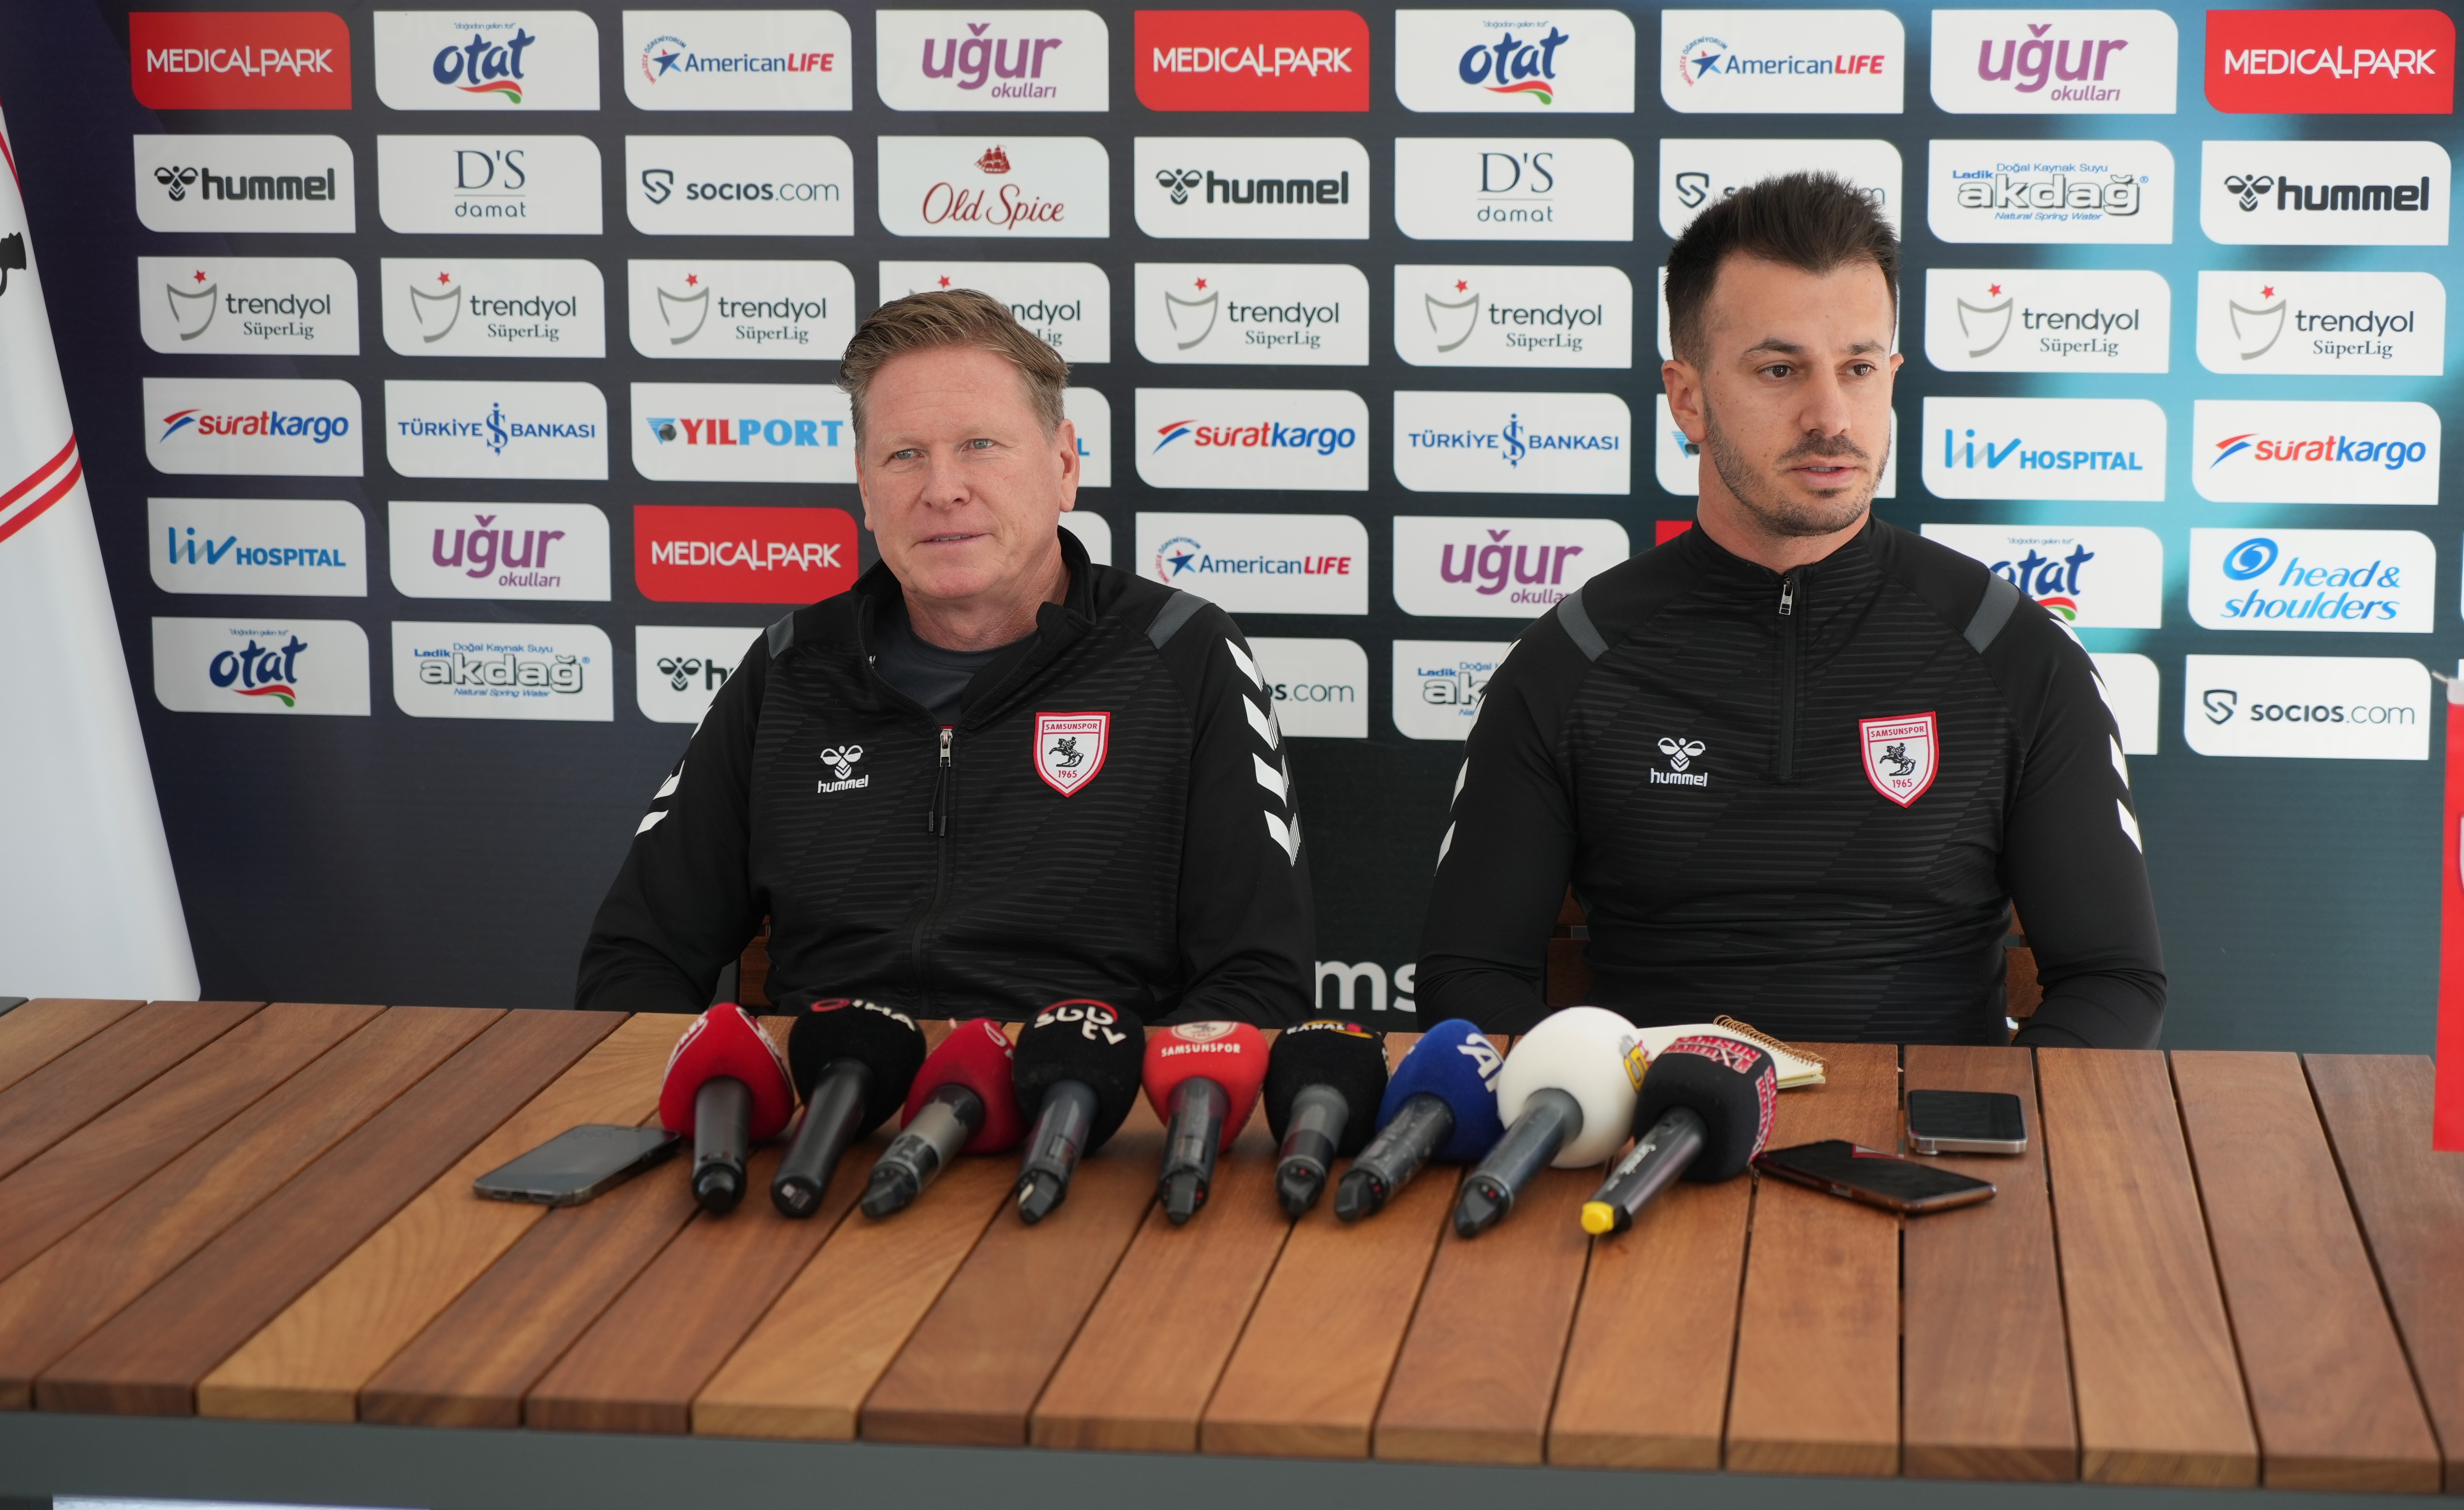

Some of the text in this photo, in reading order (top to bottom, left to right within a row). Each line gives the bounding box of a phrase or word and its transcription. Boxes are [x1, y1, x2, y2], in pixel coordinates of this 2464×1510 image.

[147, 45, 333, 77] MEDICALPARK
[433, 28, 536, 85] otat
[685, 53, 834, 72] AmericanLIFE
[922, 23, 1062, 90] uğur
[1153, 44, 1352, 77] MEDICALPARK
[1459, 27, 1569, 85] otat
[1725, 55, 1884, 74] AmericanLIFE
[1978, 24, 2128, 93] uğur
[2225, 45, 2437, 79] MEDICALPARK
[991, 83, 1056, 98] okulları
[2051, 85, 2121, 101] okulları
[453, 150, 525, 189] D'S
[1479, 153, 1553, 193] D'S
[1952, 170, 1993, 179] Ladik
[1996, 163, 2108, 174] Doğal Kaynak Suyu
[201, 167, 335, 201] hummel
[687, 183, 839, 201] socios.com
[1207, 170, 1349, 204] hummel
[2277, 176, 2429, 211] hummel
[1957, 174, 2140, 216] akdağ
[455, 201, 526, 217] damat
[923, 182, 1064, 230] Old Spice
[1477, 206, 1553, 222] damat
[2035, 213, 2068, 222] Spring
[225, 293, 330, 319] trendyol
[470, 295, 576, 321] trendyol
[718, 297, 826, 323] trendyol
[1012, 300, 1080, 325] ndyol
[1227, 301, 1338, 328] trendyol
[1488, 303, 1601, 330] trendyol
[2022, 308, 2139, 335] trendyol
[2295, 310, 2414, 337] trendyol
[244, 322, 314, 340] SüperLig
[488, 324, 559, 342] SüperLig
[736, 326, 808, 344] SüperLig
[1246, 331, 1320, 349] SüperLig
[1506, 333, 1582, 352] SüperLig
[2040, 338, 2119, 357] SüperLig
[2313, 340, 2393, 359] SüperLig
[398, 418, 483, 436] TÜRKİYE
[511, 423, 595, 438] BANKASI
[680, 418, 843, 447] YILPORT
[1408, 430, 1499, 448] TÜRKİYE
[1529, 435, 1618, 450] BANKASI
[1945, 429, 2143, 470] liv HOSPITAL
[168, 527, 346, 567] liv HOSPITAL
[432, 515, 565, 578] uğur
[651, 539, 841, 572] MEDICALPARK
[1199, 555, 1351, 575] AmericanLIFE
[1440, 529, 1584, 595] uğur
[2279, 557, 2381, 587] head
[498, 572, 560, 587] okulları
[1511, 589, 1572, 603] okulla
[2220, 589, 2401, 620] shoulders
[414, 649, 451, 658] Ladik
[453, 643, 553, 654] Doğal Kaynak Suyu
[210, 635, 308, 688] otat
[1460, 662, 1492, 671] Doğal
[420, 652, 583, 693] akdağ
[1419, 668, 1457, 676] Ladik
[489, 689, 519, 698] Spring
[2250, 704, 2414, 724] socios.com
[1045, 722, 1098, 731] SAMSUNSPOR
[1870, 726, 1924, 738] SAMSUNSPOR
[817, 775, 869, 793] hummel
[1058, 770, 1078, 778] 1965
[1650, 768, 1708, 787] hummel
[1892, 778, 1913, 789] 1965
[1161, 1042, 1241, 1057] SAMSUNSPOR
